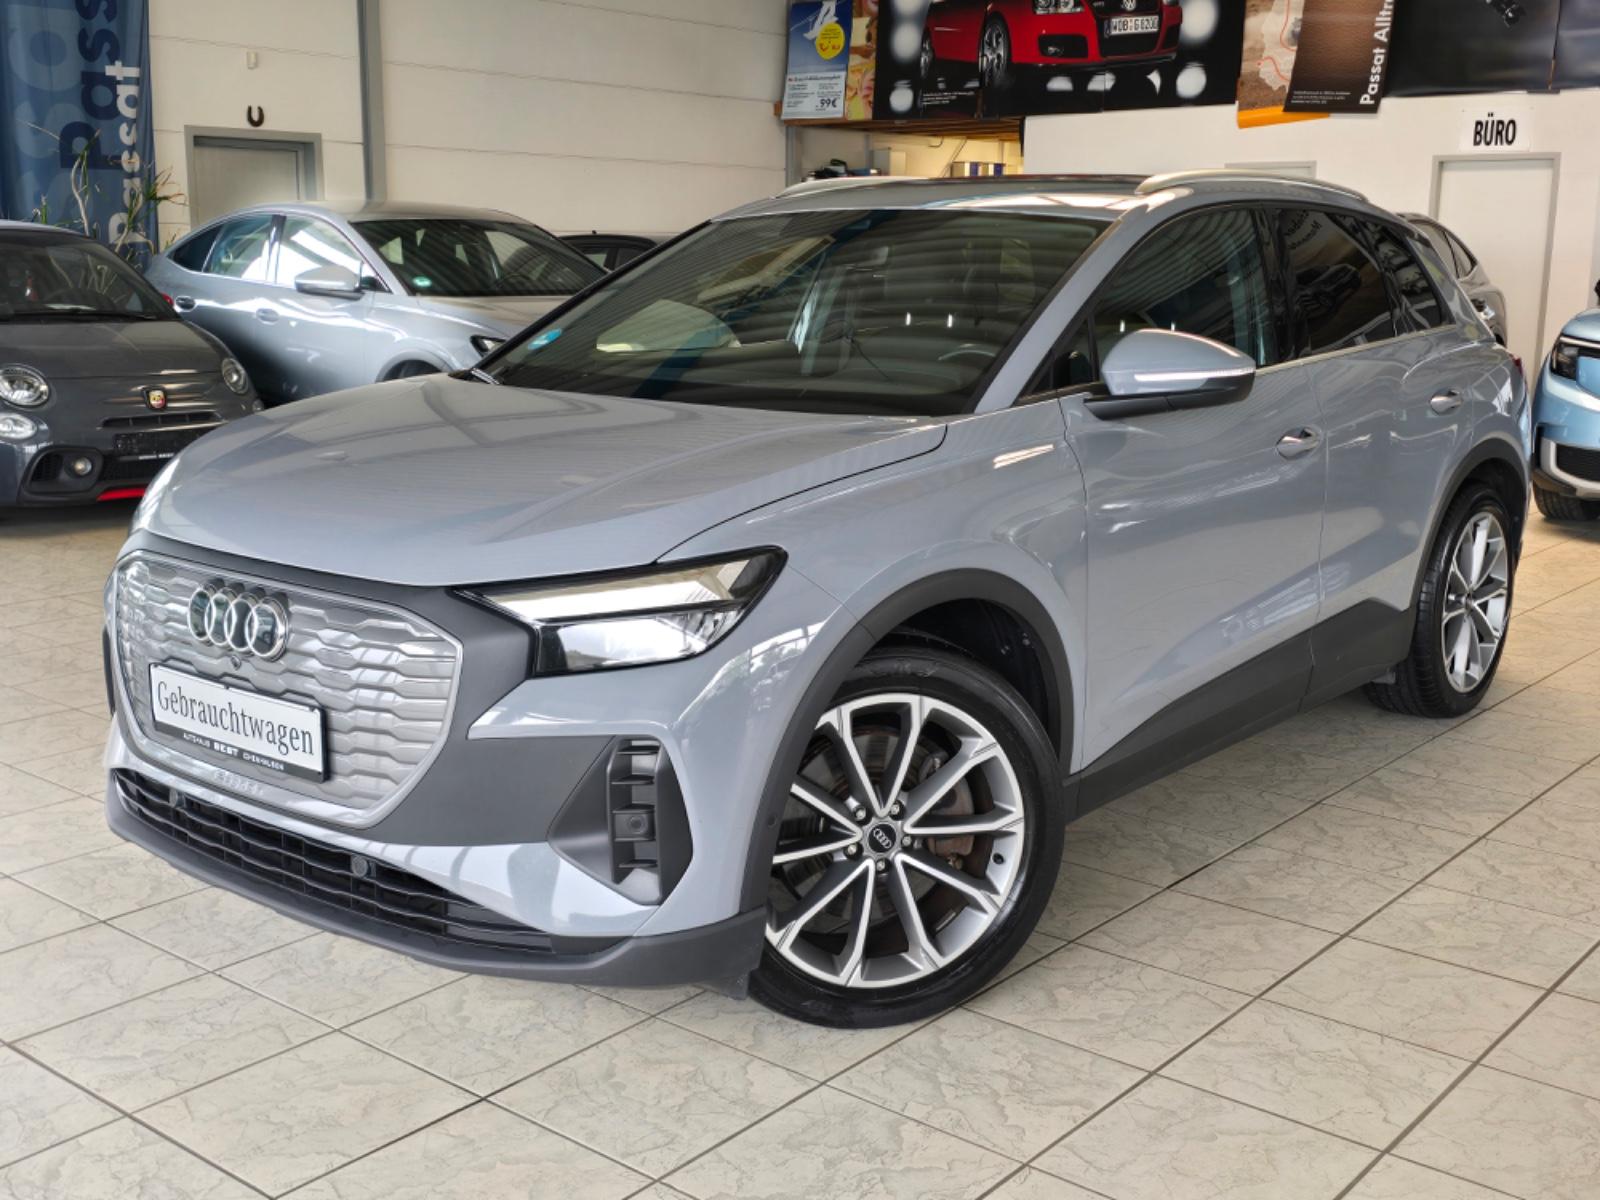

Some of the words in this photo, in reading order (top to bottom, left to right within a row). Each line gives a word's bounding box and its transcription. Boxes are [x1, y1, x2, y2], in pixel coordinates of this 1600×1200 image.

[1359, 47, 1386, 104] Passat
[1373, 0, 1394, 42] Alltr
[105, 60, 146, 244] Passat
[1473, 112, 1516, 146] BÜRO
[157, 681, 314, 755] Gebrauchtwagen
